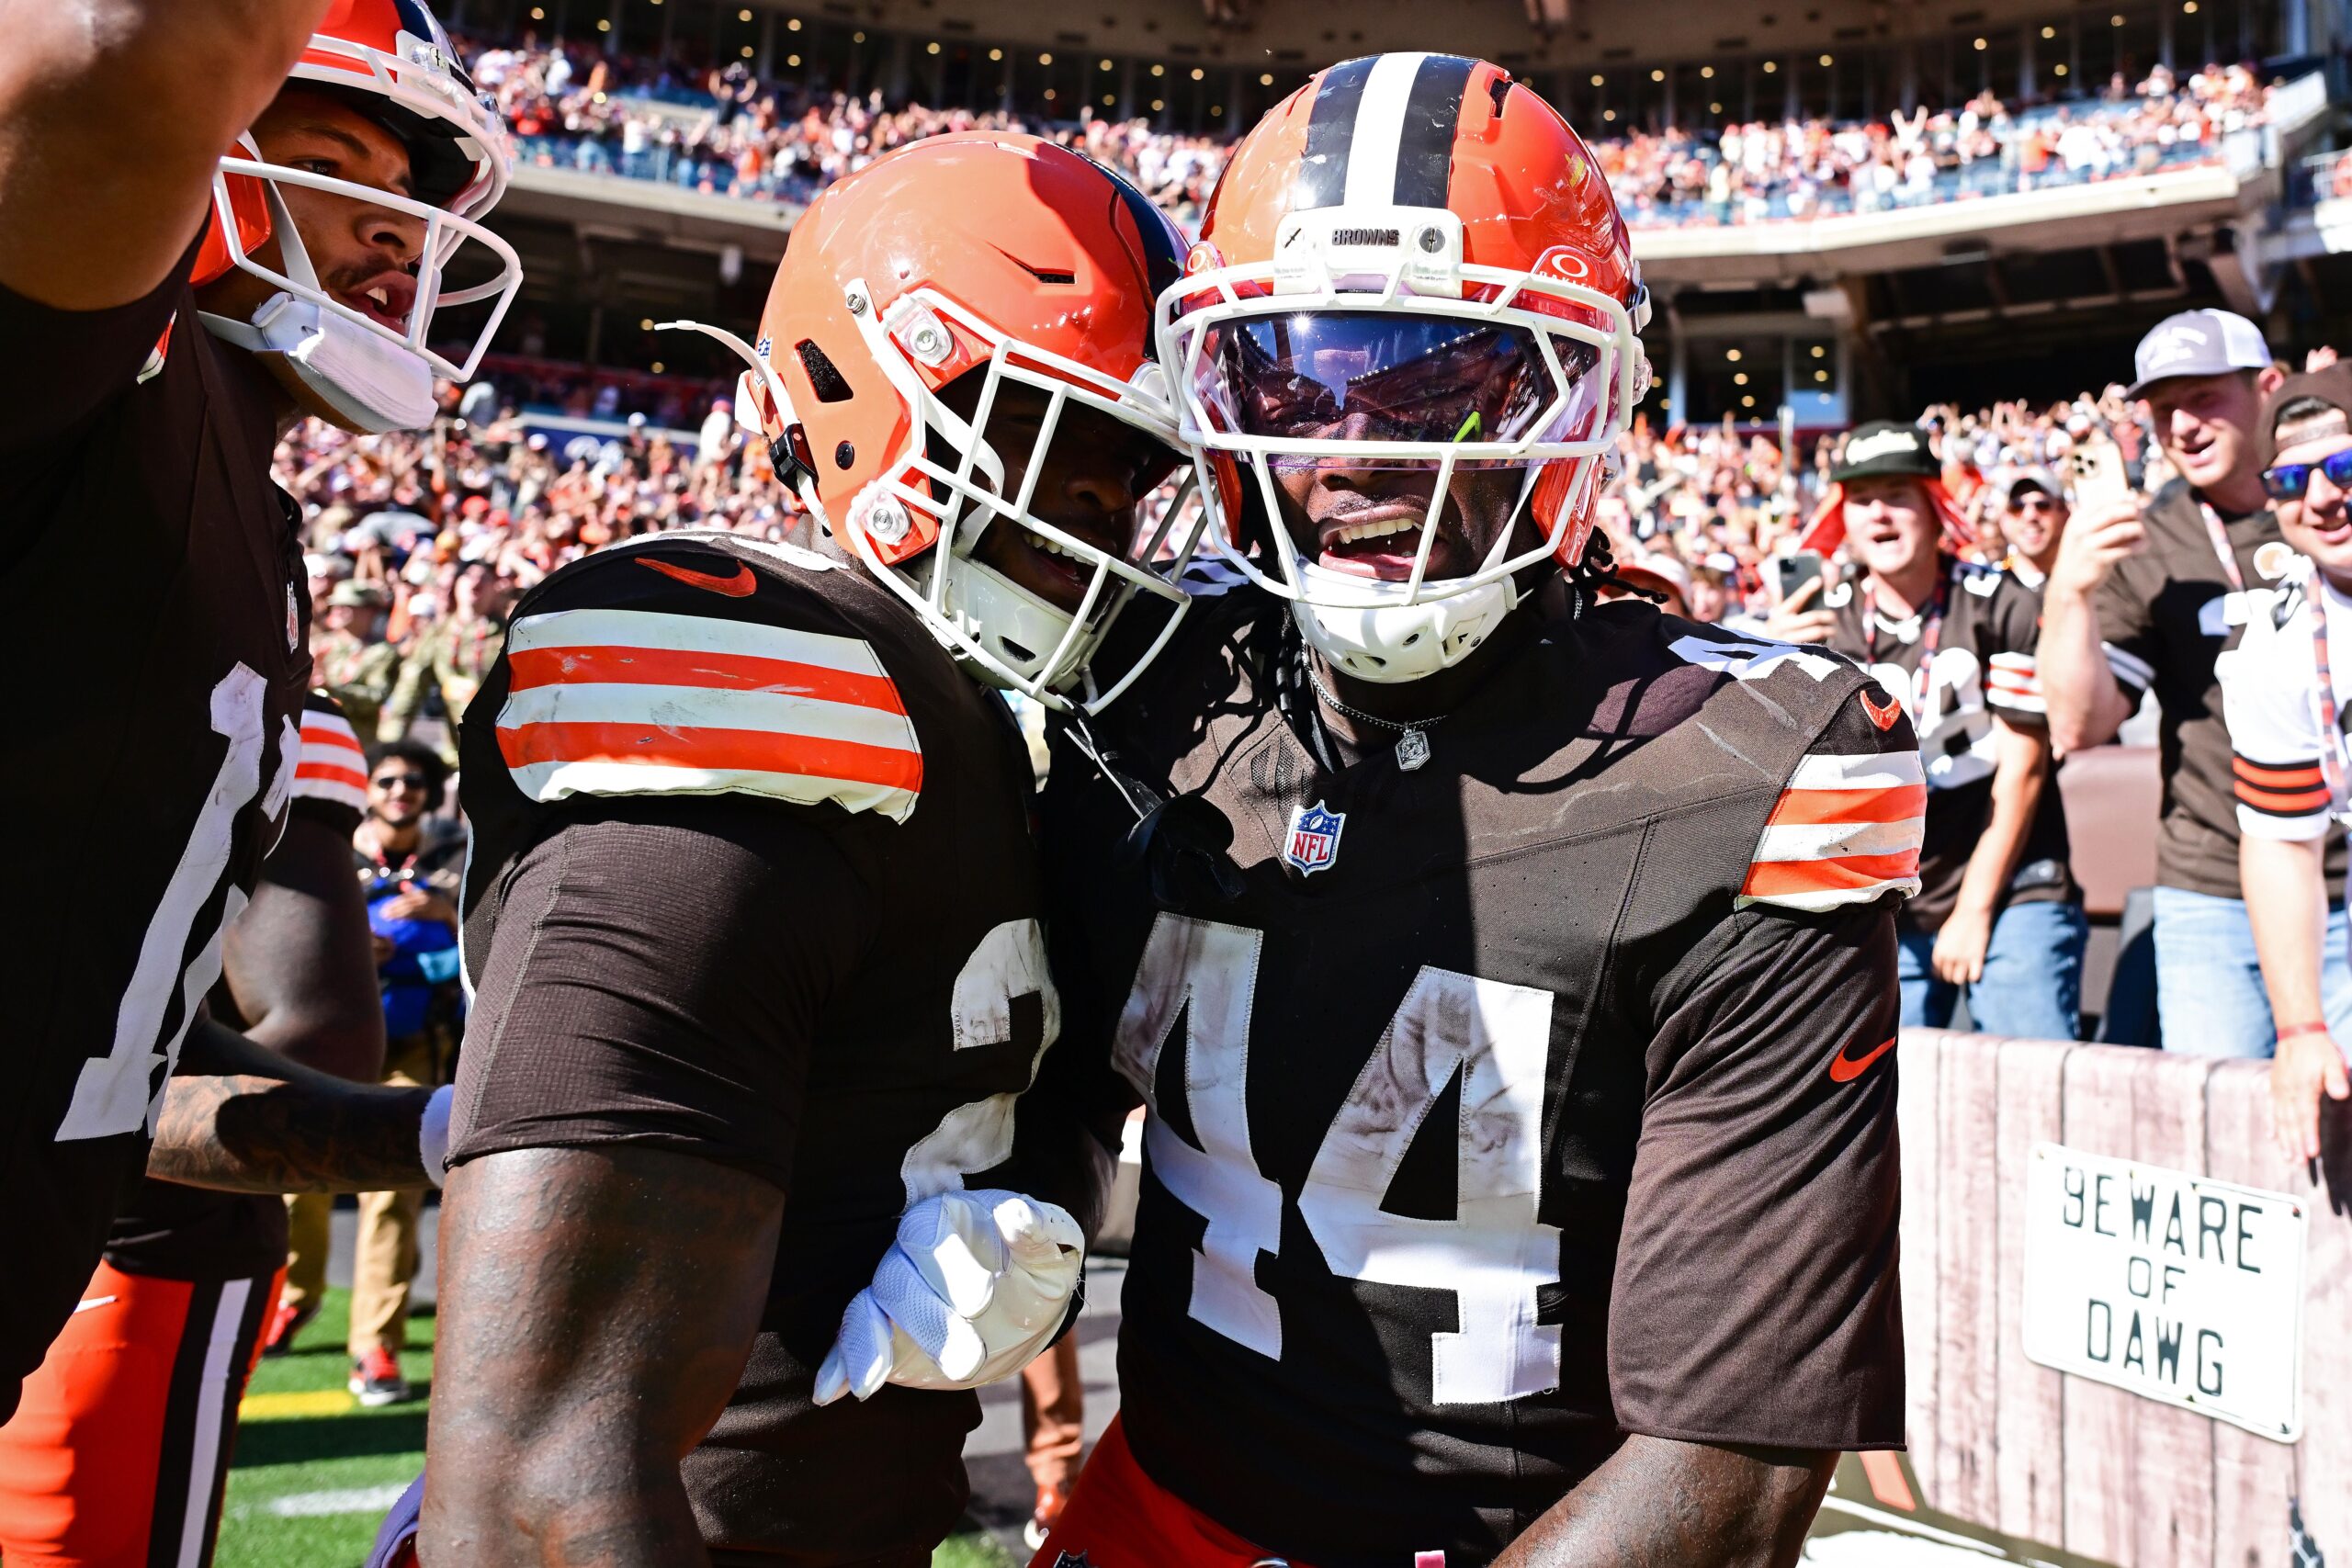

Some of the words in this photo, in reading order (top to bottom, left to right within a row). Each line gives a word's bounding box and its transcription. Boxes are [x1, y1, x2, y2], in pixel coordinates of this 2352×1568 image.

[1331, 228, 1399, 246] BROWNS
[1292, 831, 1329, 863] NFL
[1110, 910, 1565, 1406] 44
[2064, 1166, 2264, 1274] BEWARE
[2128, 1255, 2187, 1305] OF
[2086, 1298, 2224, 1397] DAWG
